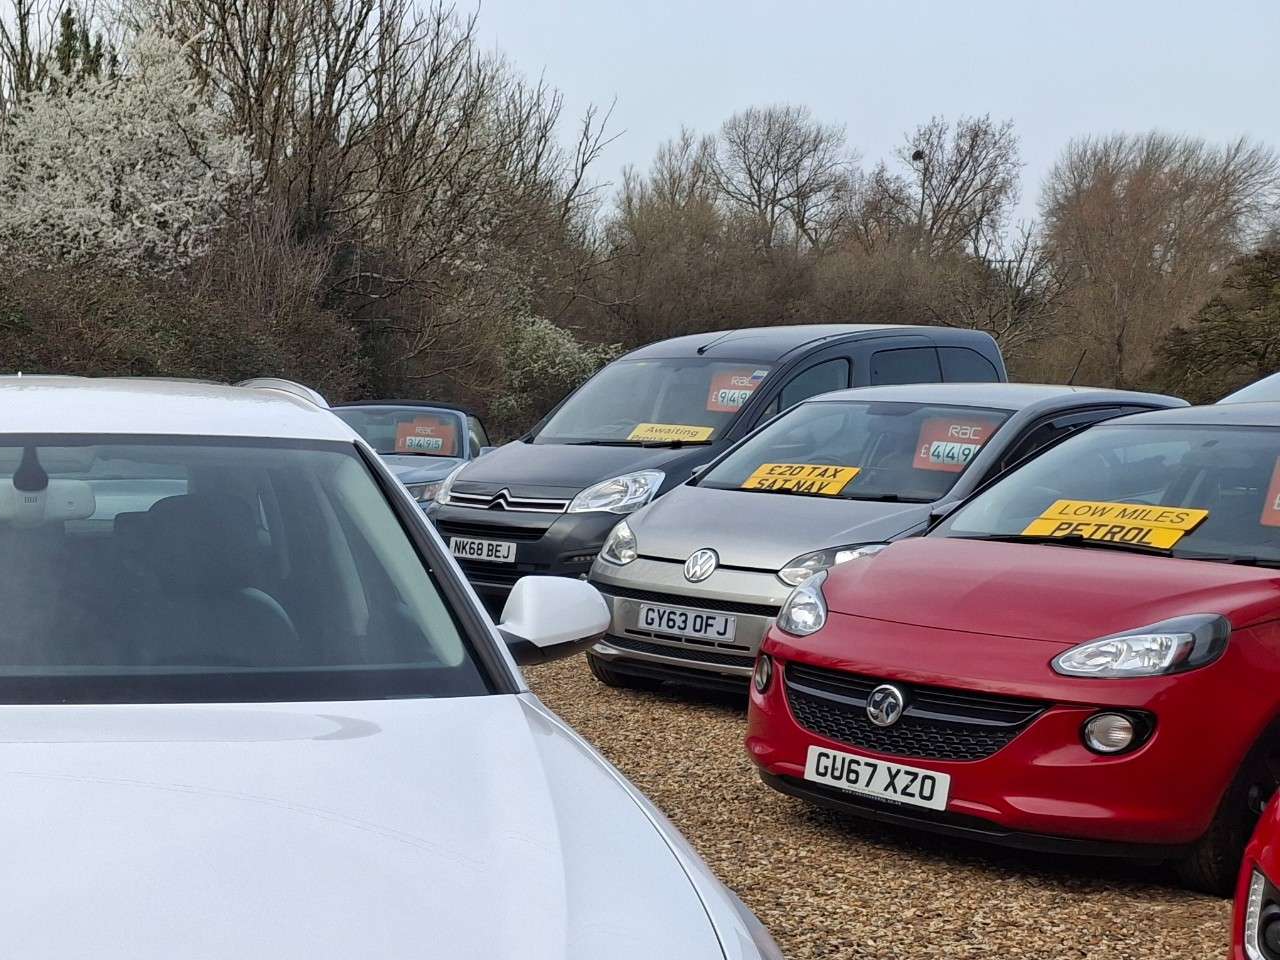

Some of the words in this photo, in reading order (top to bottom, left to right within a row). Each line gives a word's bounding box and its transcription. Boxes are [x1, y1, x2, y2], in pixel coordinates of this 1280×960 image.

[646, 426, 699, 437] Awaiting
[765, 465, 804, 476] £20
[806, 467, 844, 479] TAX
[755, 478, 794, 490] SAT
[792, 479, 831, 494] NAV
[1058, 504, 1113, 518] LOW
[1114, 507, 1190, 524] MILES
[1050, 522, 1153, 545] PETROL
[453, 540, 485, 557] NK68
[486, 543, 512, 559] BEJ
[645, 609, 688, 631] GY63
[692, 615, 730, 637] OFJ
[815, 752, 878, 788] GU67
[883, 766, 936, 802] XZO
